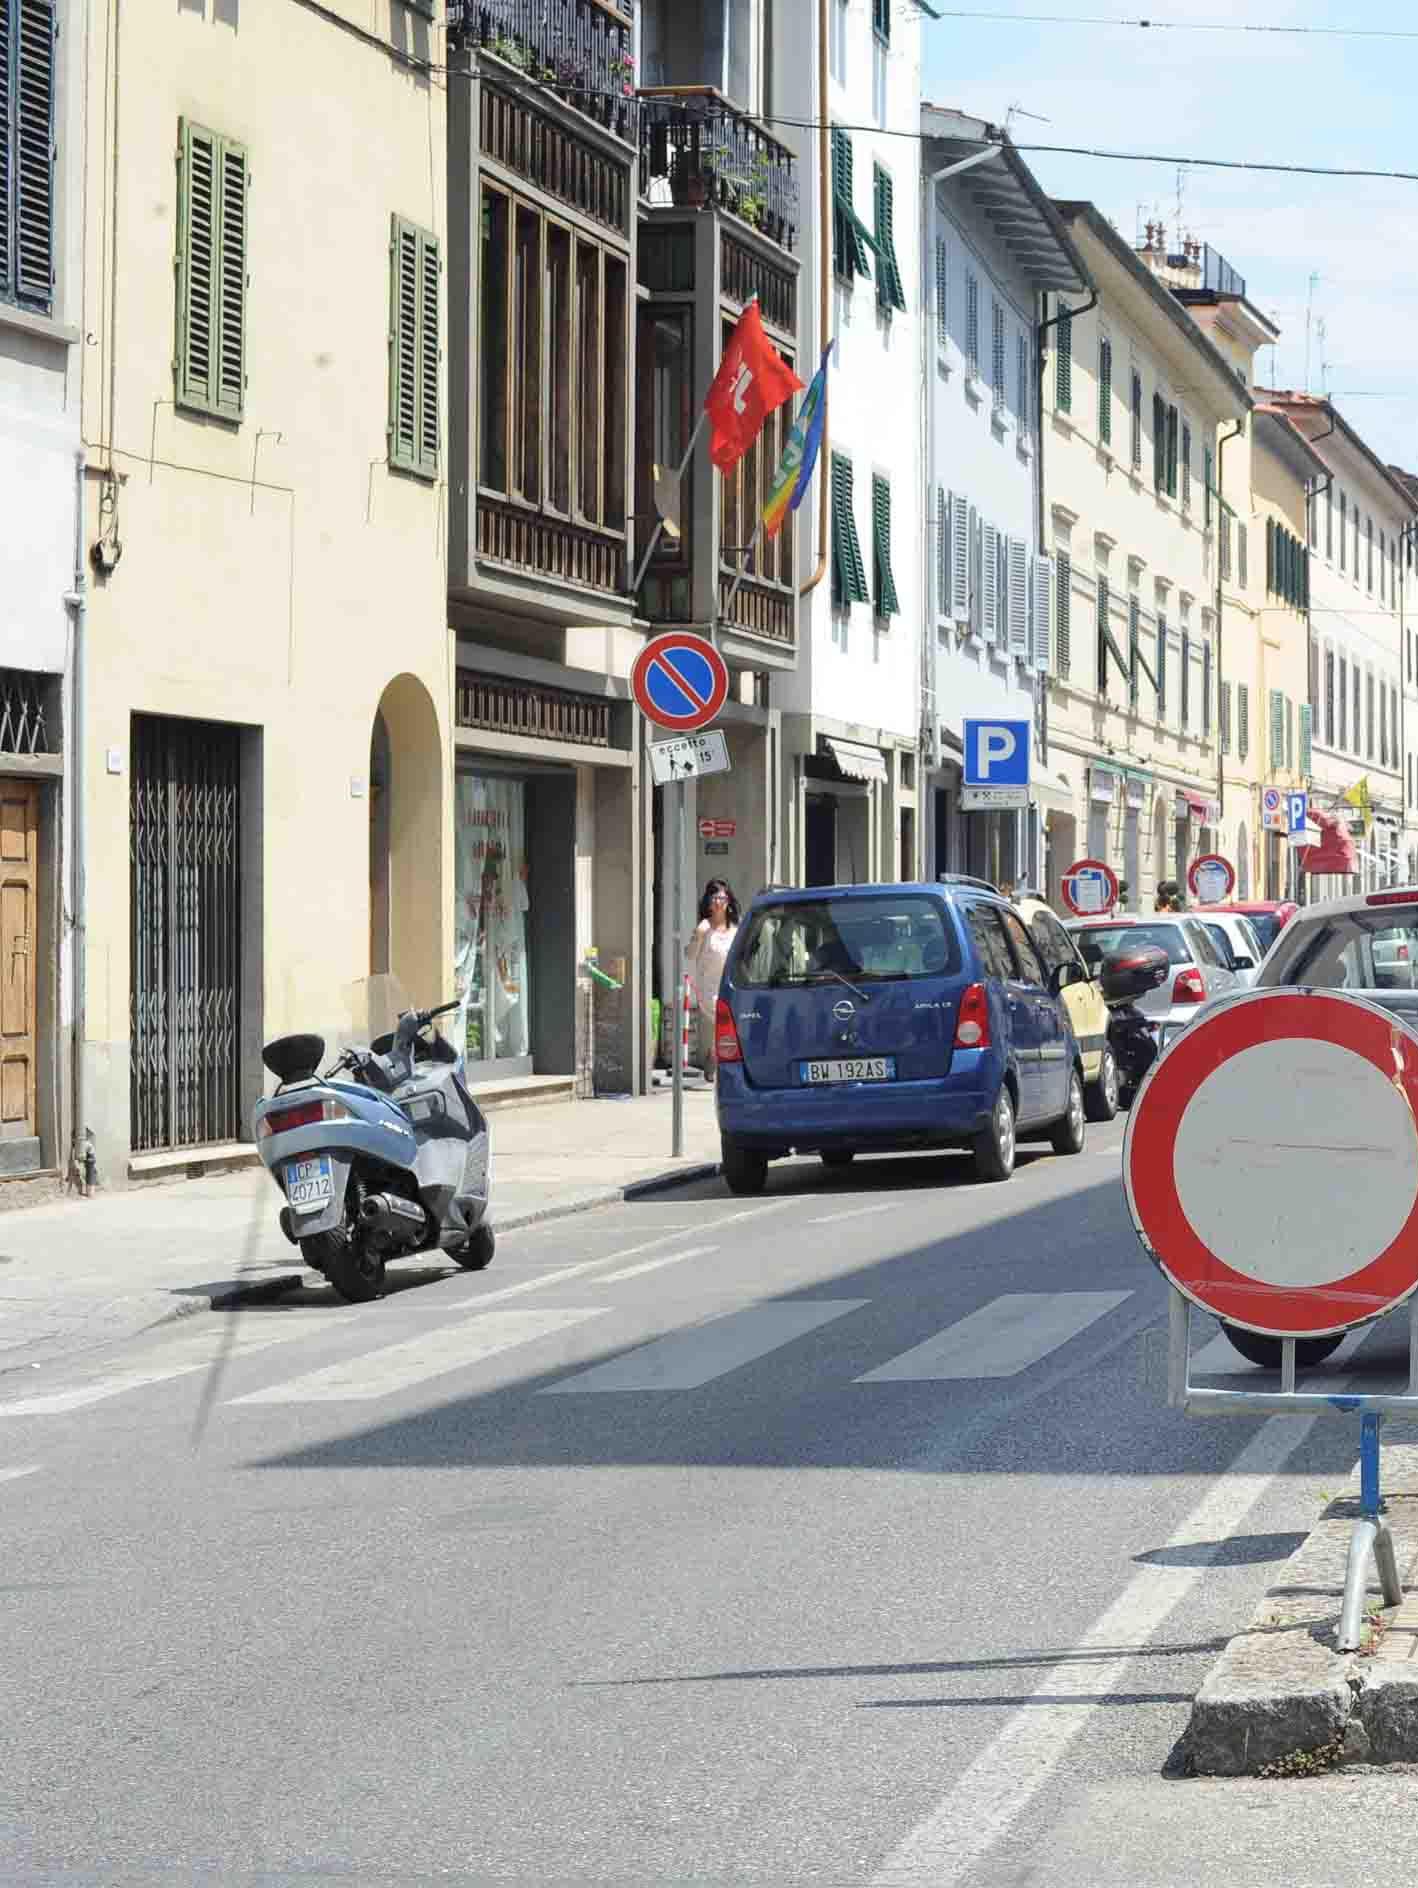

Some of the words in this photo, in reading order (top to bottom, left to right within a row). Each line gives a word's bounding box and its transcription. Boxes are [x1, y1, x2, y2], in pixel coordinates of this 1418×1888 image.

[977, 726, 1017, 779] P
[1291, 797, 1303, 829] P
[811, 1063, 829, 1081] BW
[838, 1060, 885, 1079] 192AS
